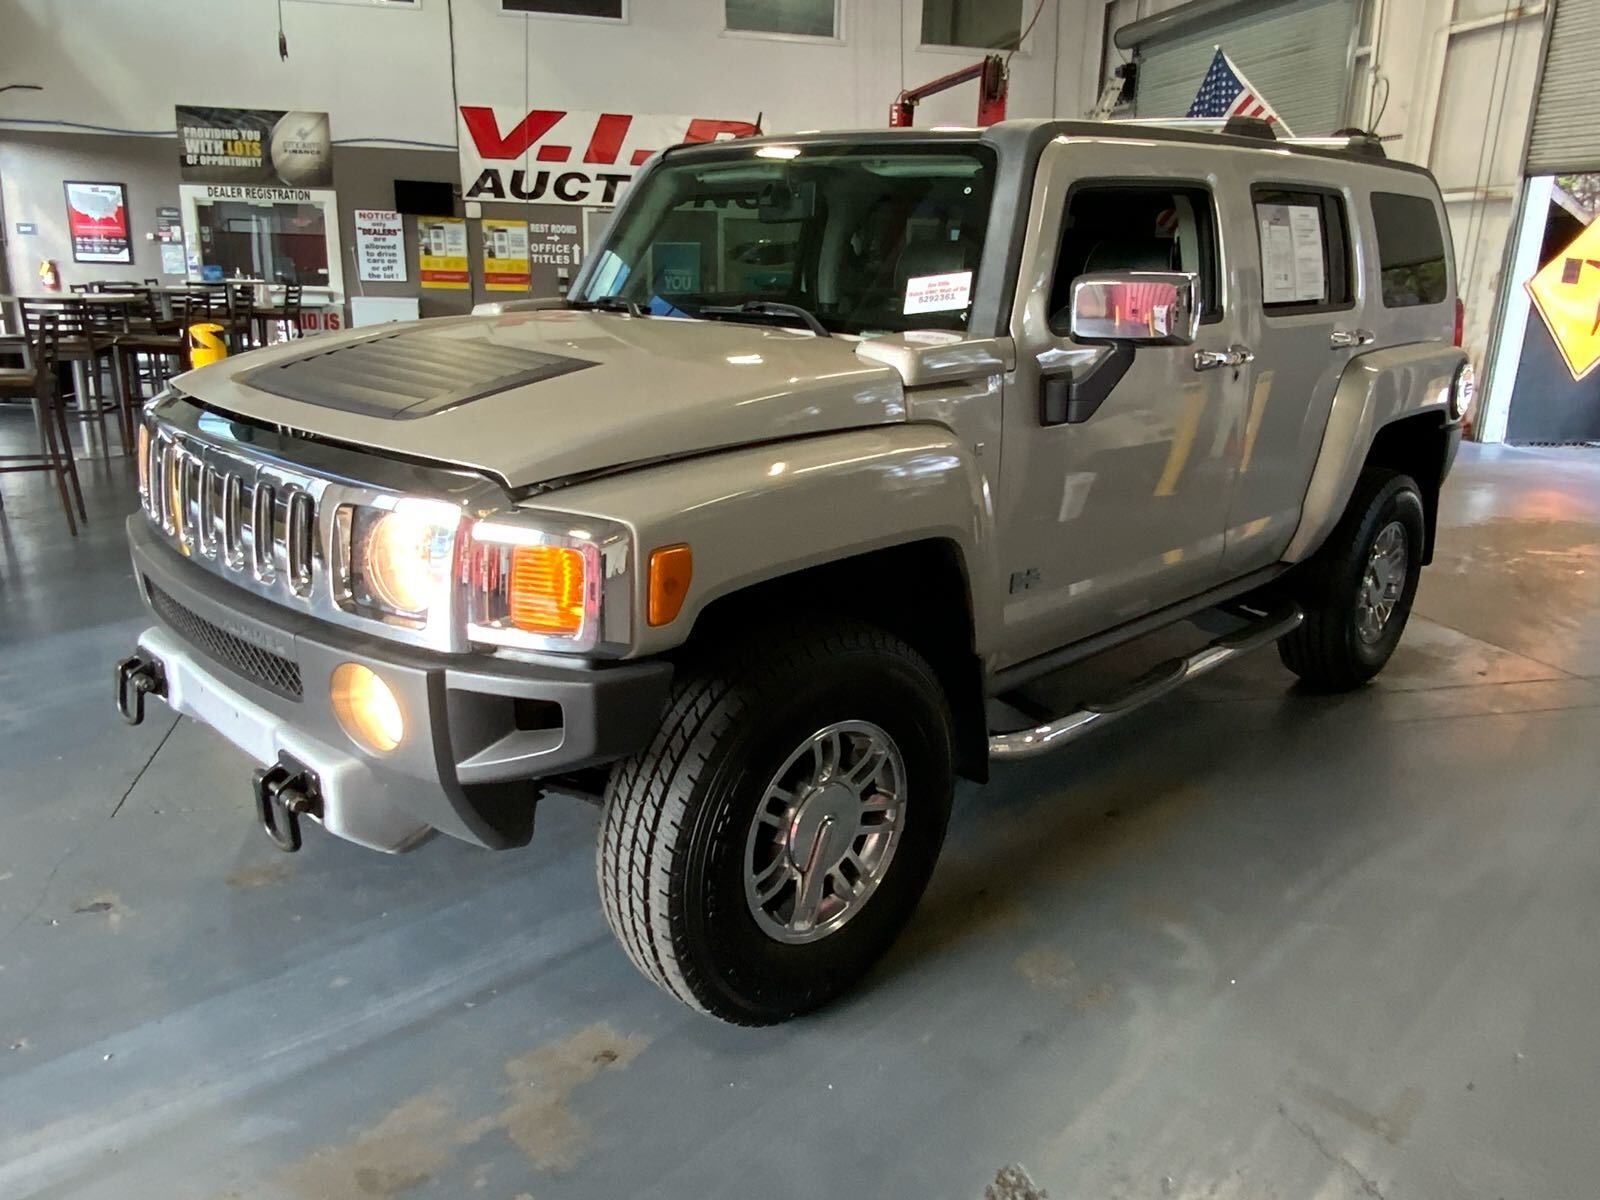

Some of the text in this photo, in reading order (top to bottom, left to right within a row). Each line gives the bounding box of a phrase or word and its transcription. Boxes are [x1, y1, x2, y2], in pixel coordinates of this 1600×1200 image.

[183, 126, 261, 142] PROVIDING YOU
[184, 138, 262, 157] WITH LOTS
[186, 155, 263, 167] OF OPPORTUNITY
[207, 187, 311, 201] DEALER REGISTRATION
[358, 212, 398, 221] NOTICE
[529, 223, 577, 234] REST ROOMS
[530, 243, 570, 254] OFFICE
[531, 254, 570, 264] TITLES
[664, 275, 692, 291] YOU
[918, 293, 957, 304] 5292361
